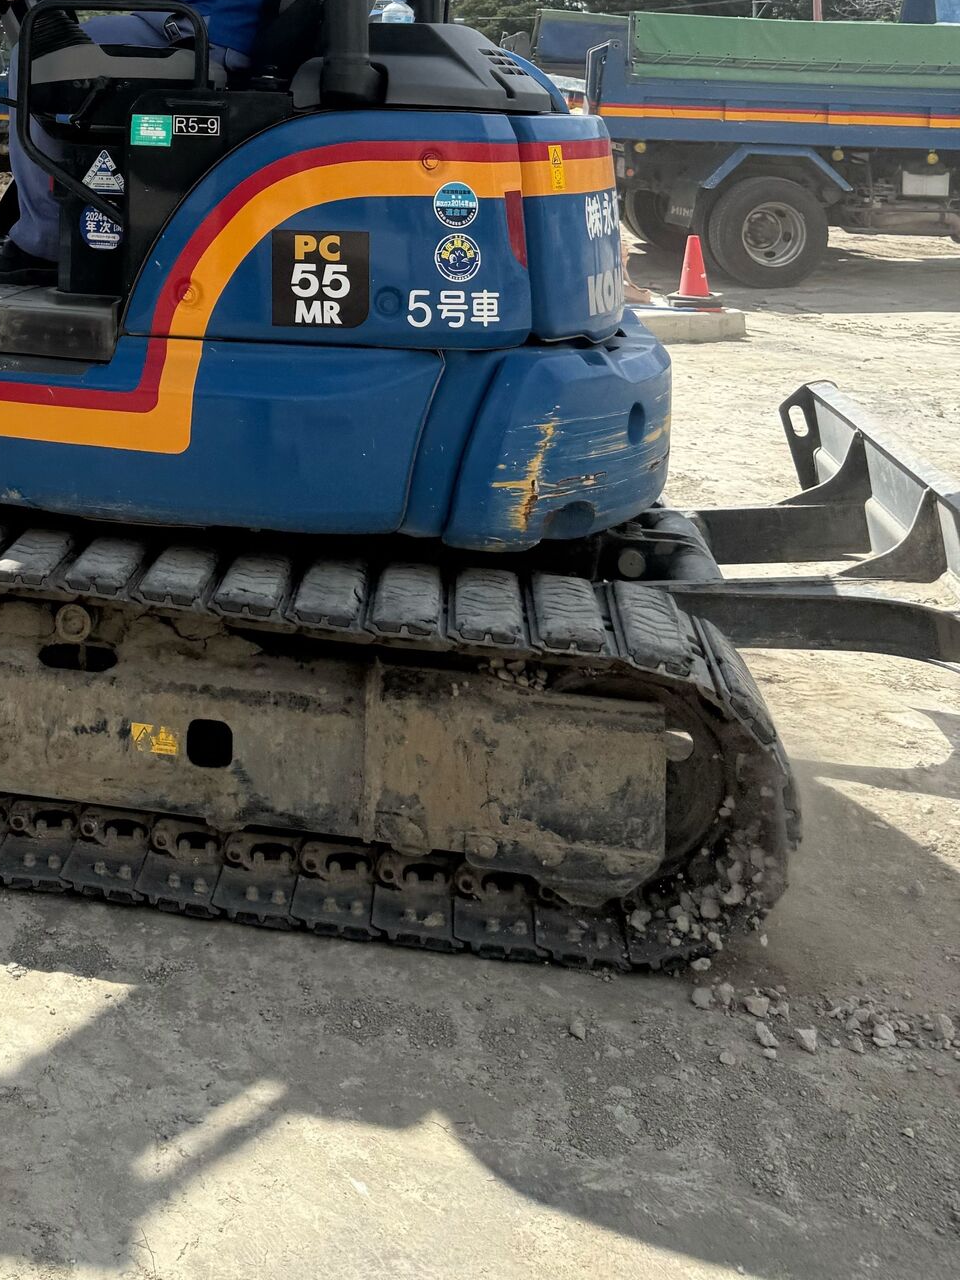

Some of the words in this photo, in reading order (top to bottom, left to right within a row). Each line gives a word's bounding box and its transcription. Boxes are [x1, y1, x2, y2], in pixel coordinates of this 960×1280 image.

[175, 117, 218, 134] R5-9
[295, 234, 341, 261] PC
[291, 263, 351, 299] 55
[295, 300, 343, 324] MR
[407, 289, 500, 328] 5号車
